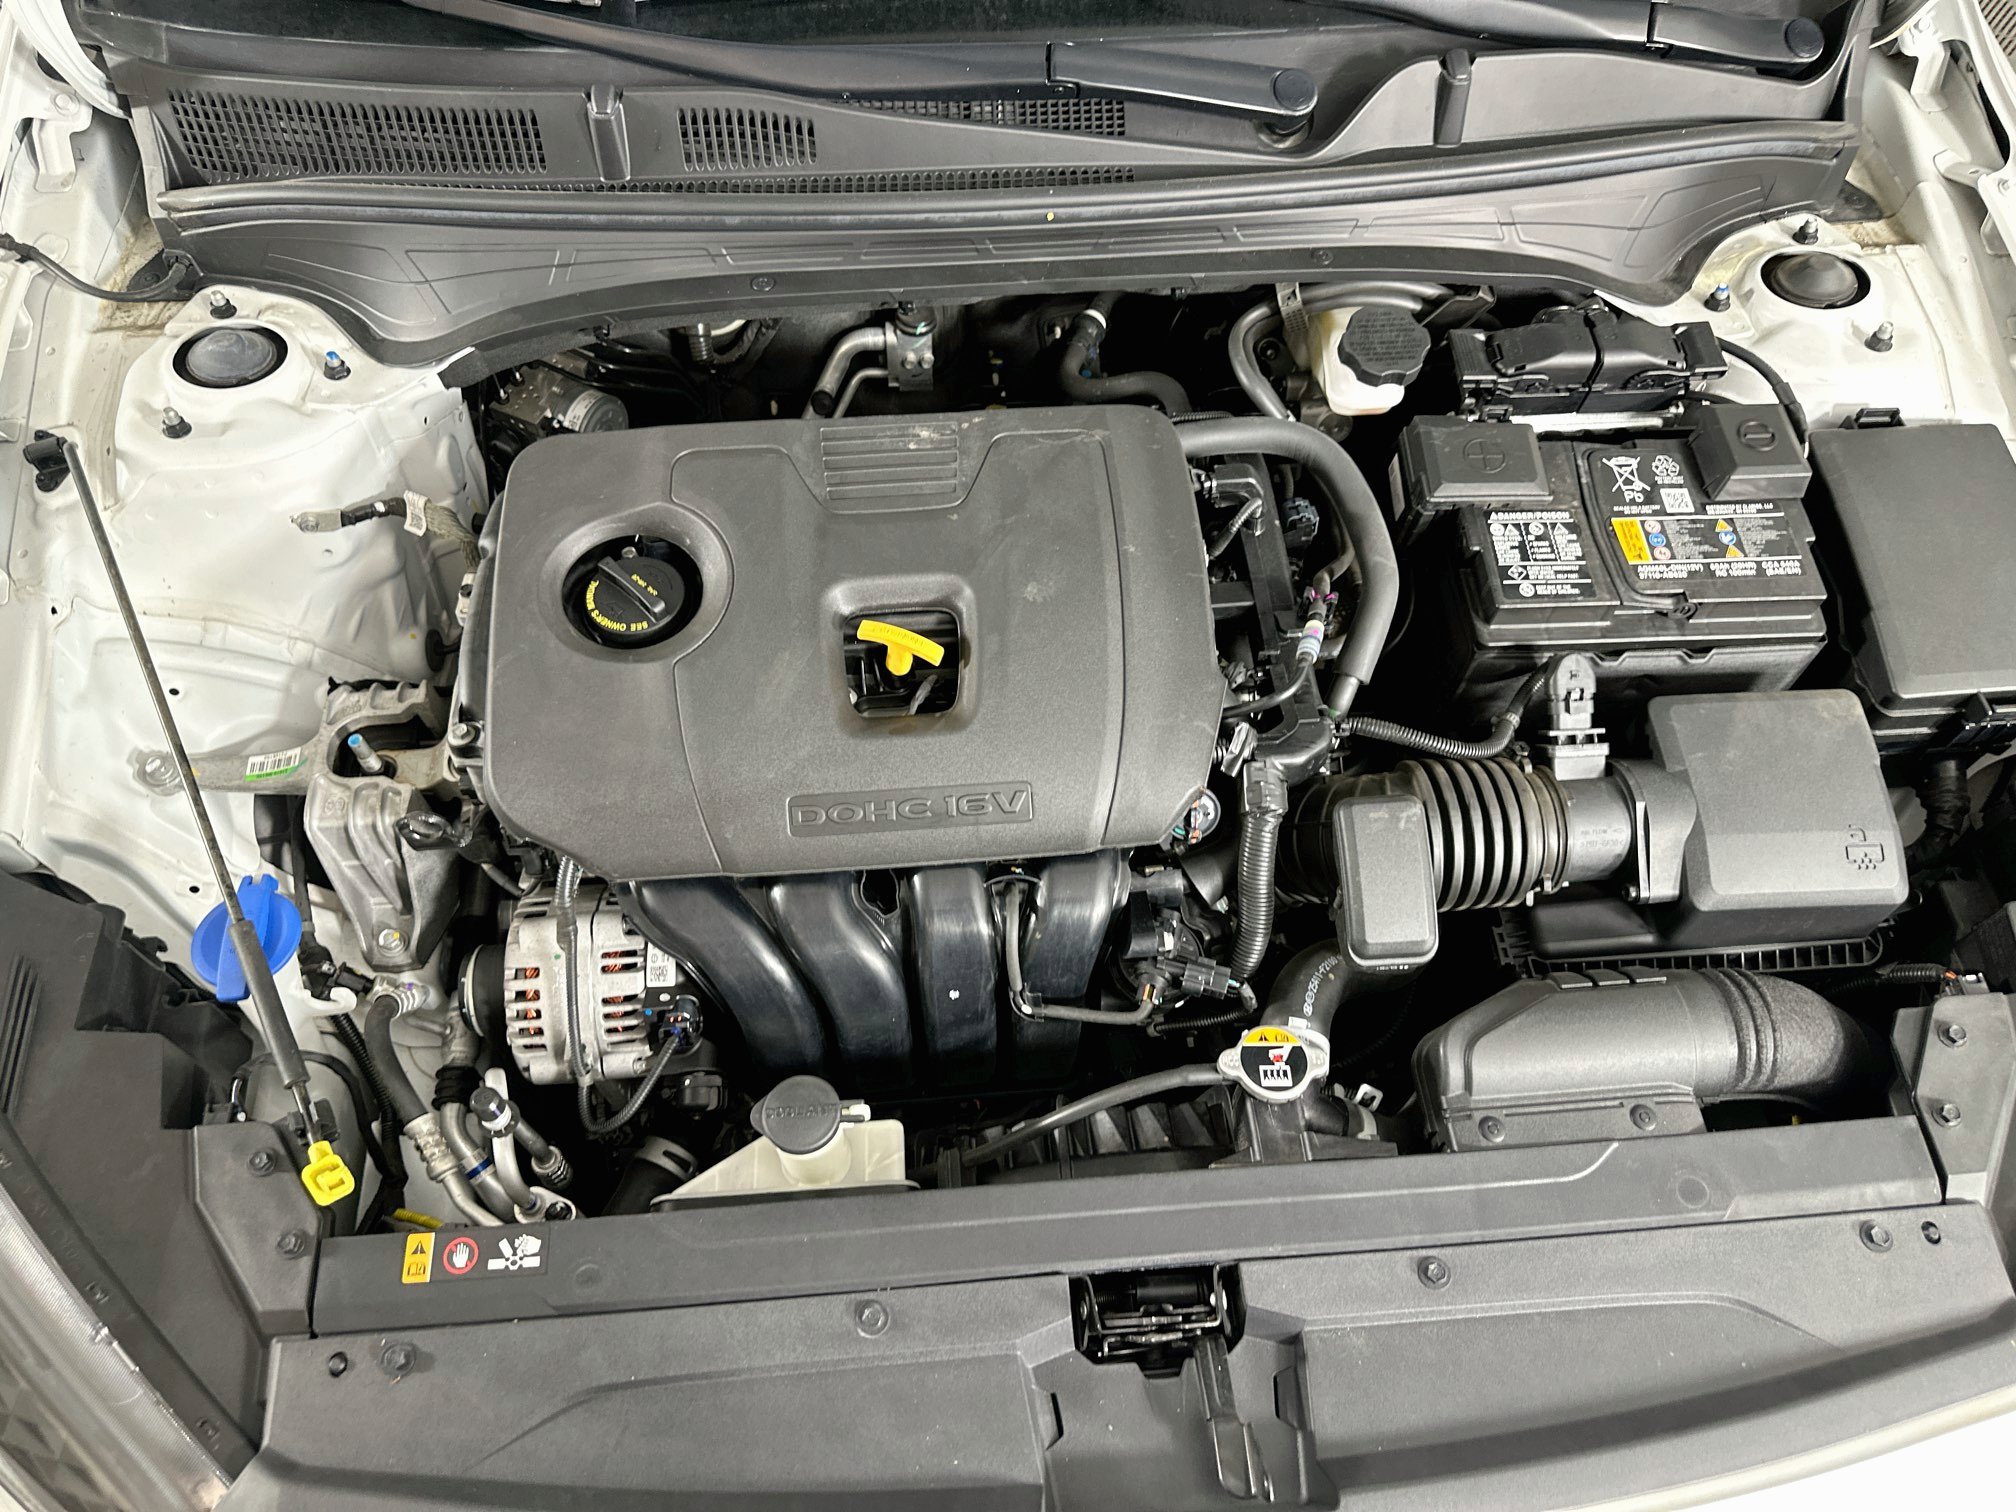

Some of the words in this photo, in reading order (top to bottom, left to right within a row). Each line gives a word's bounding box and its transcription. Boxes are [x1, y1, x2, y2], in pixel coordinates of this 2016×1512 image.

[1624, 490, 1644, 502] Pb
[630, 620, 648, 632] SEE
[790, 798, 933, 826] DOHC
[943, 790, 1028, 818] 16V
[765, 1103, 838, 1120] COOLANT
